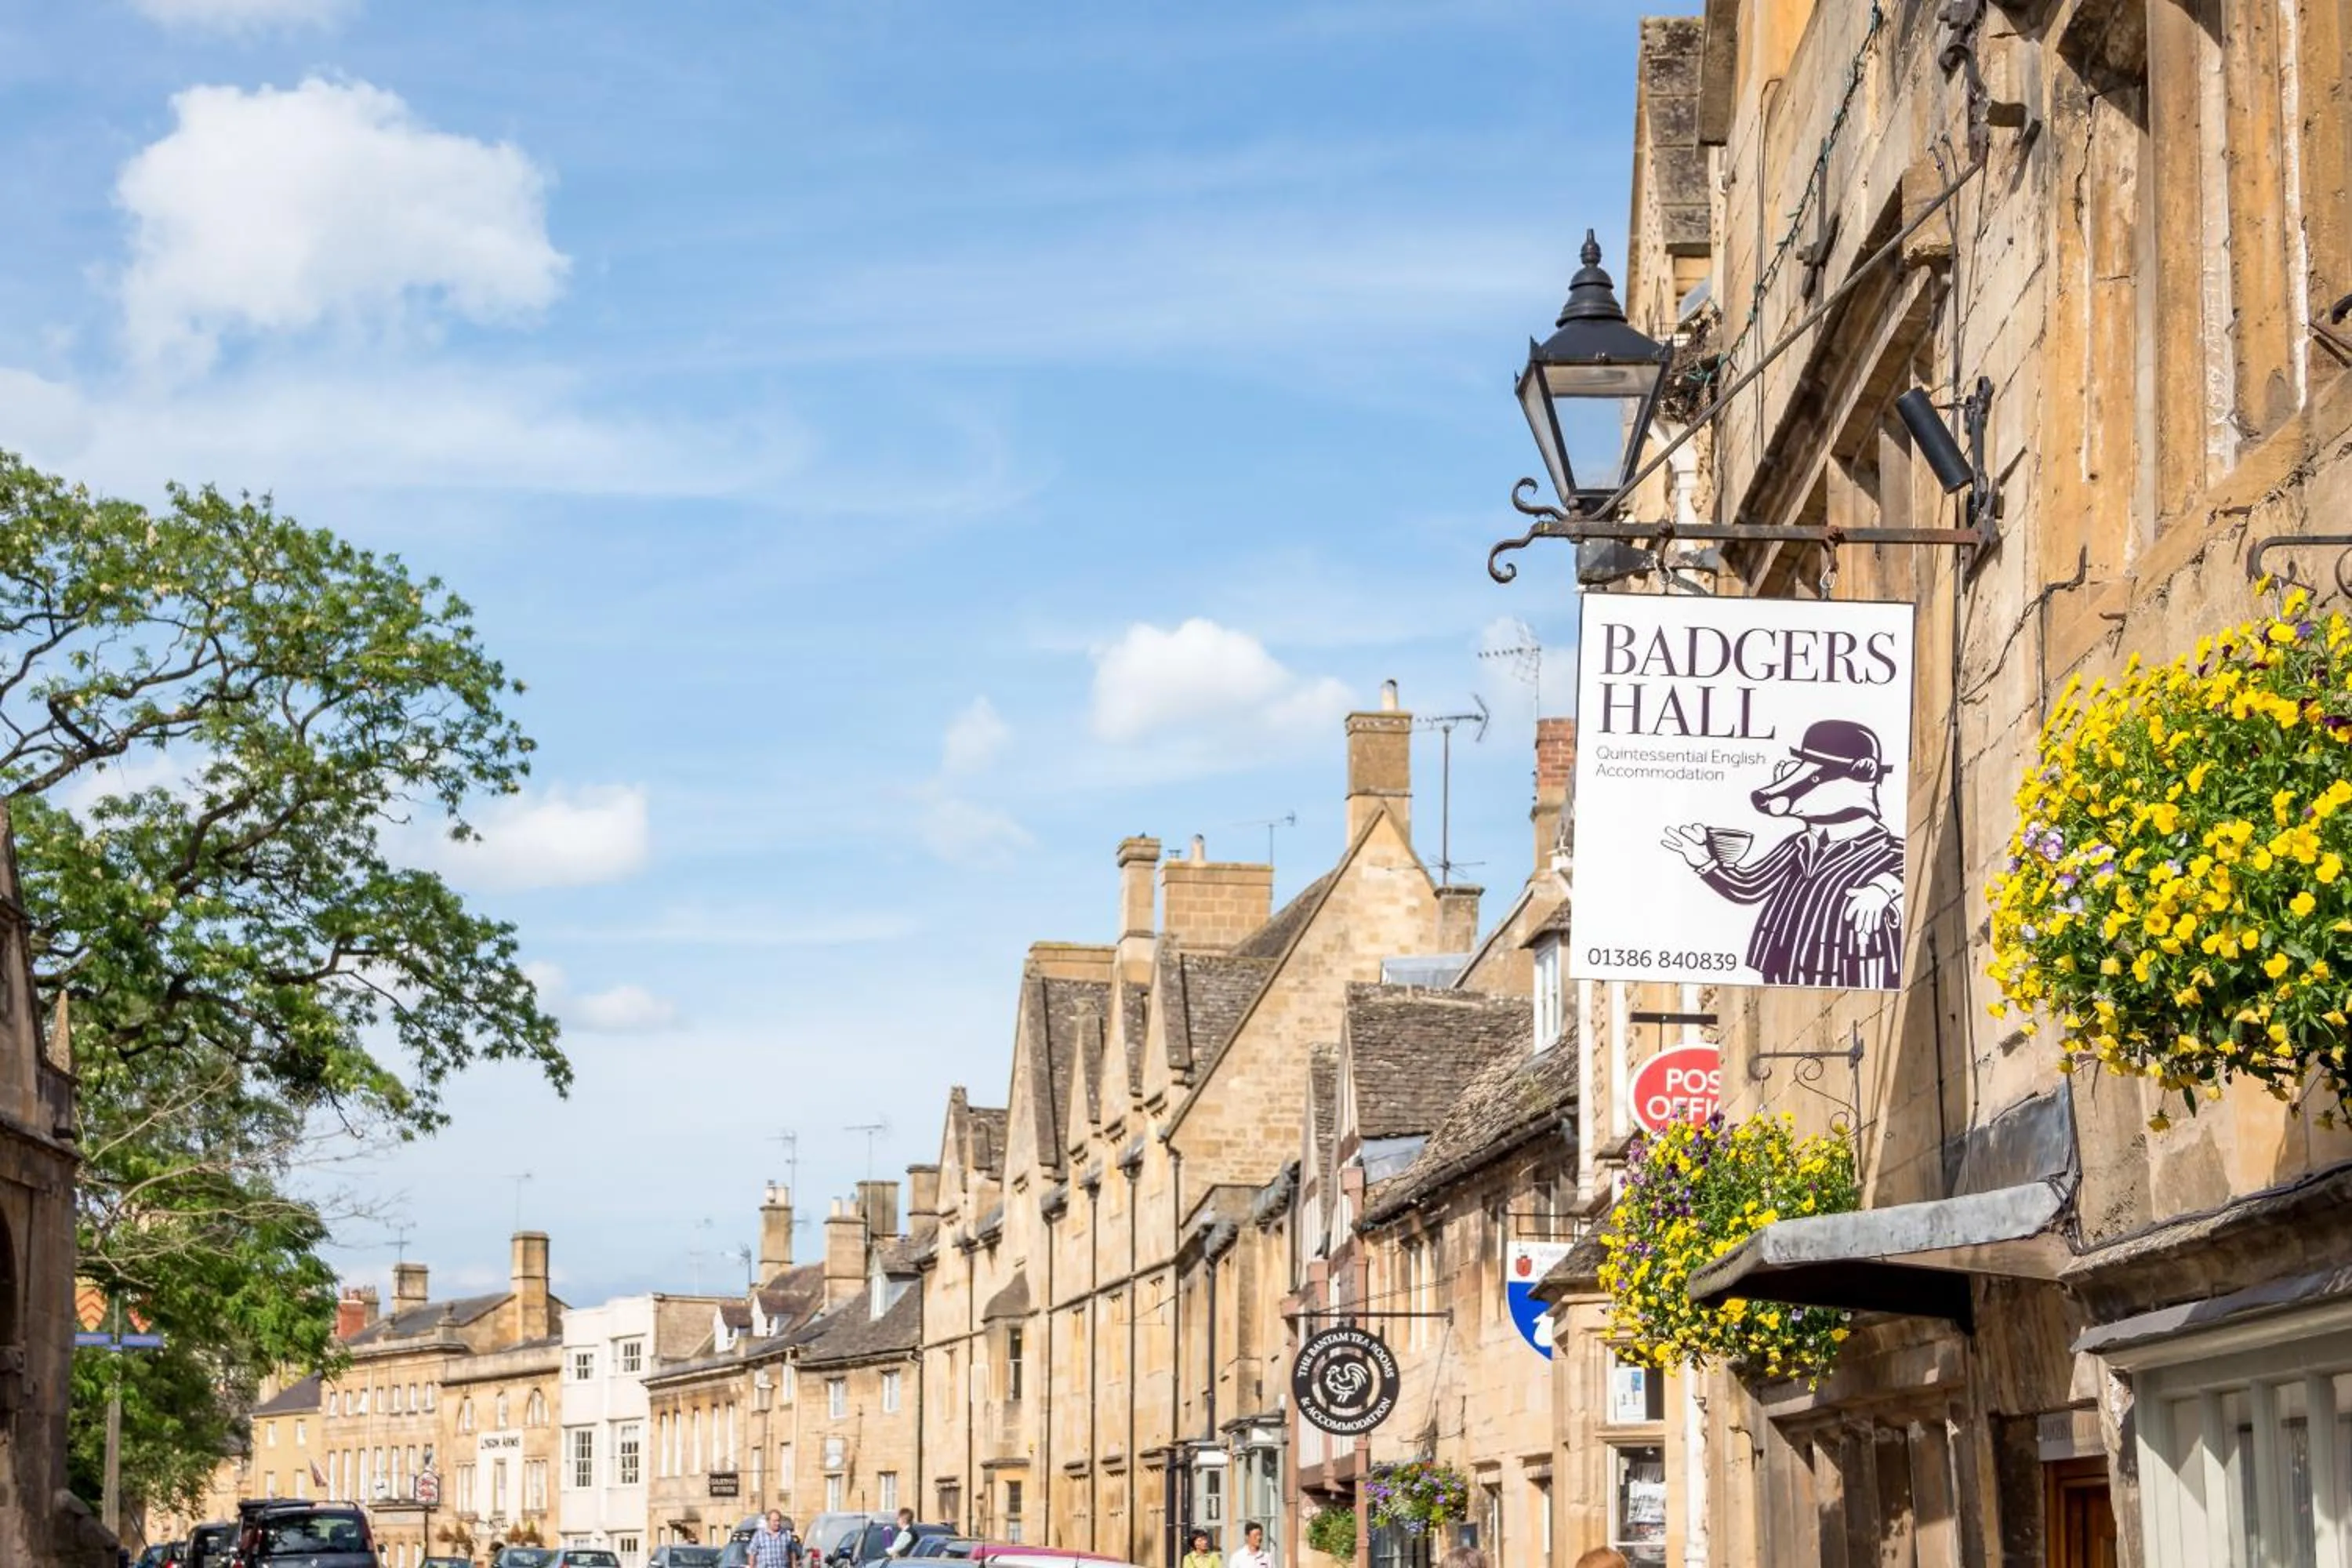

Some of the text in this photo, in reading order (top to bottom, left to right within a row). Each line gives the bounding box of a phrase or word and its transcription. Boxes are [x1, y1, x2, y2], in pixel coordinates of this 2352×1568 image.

[1599, 623, 1896, 685] BADGERS
[1597, 682, 1776, 740] HALL
[1595, 746, 1766, 768] Quintessential English
[1595, 763, 1725, 781] Accommodation
[1588, 948, 1737, 971] 01386 840839
[1665, 1068, 1719, 1094] POS
[1298, 1332, 1395, 1378] THE BANTAM TEA ROOMS
[1301, 1396, 1392, 1432] & ACCOMMODATION
